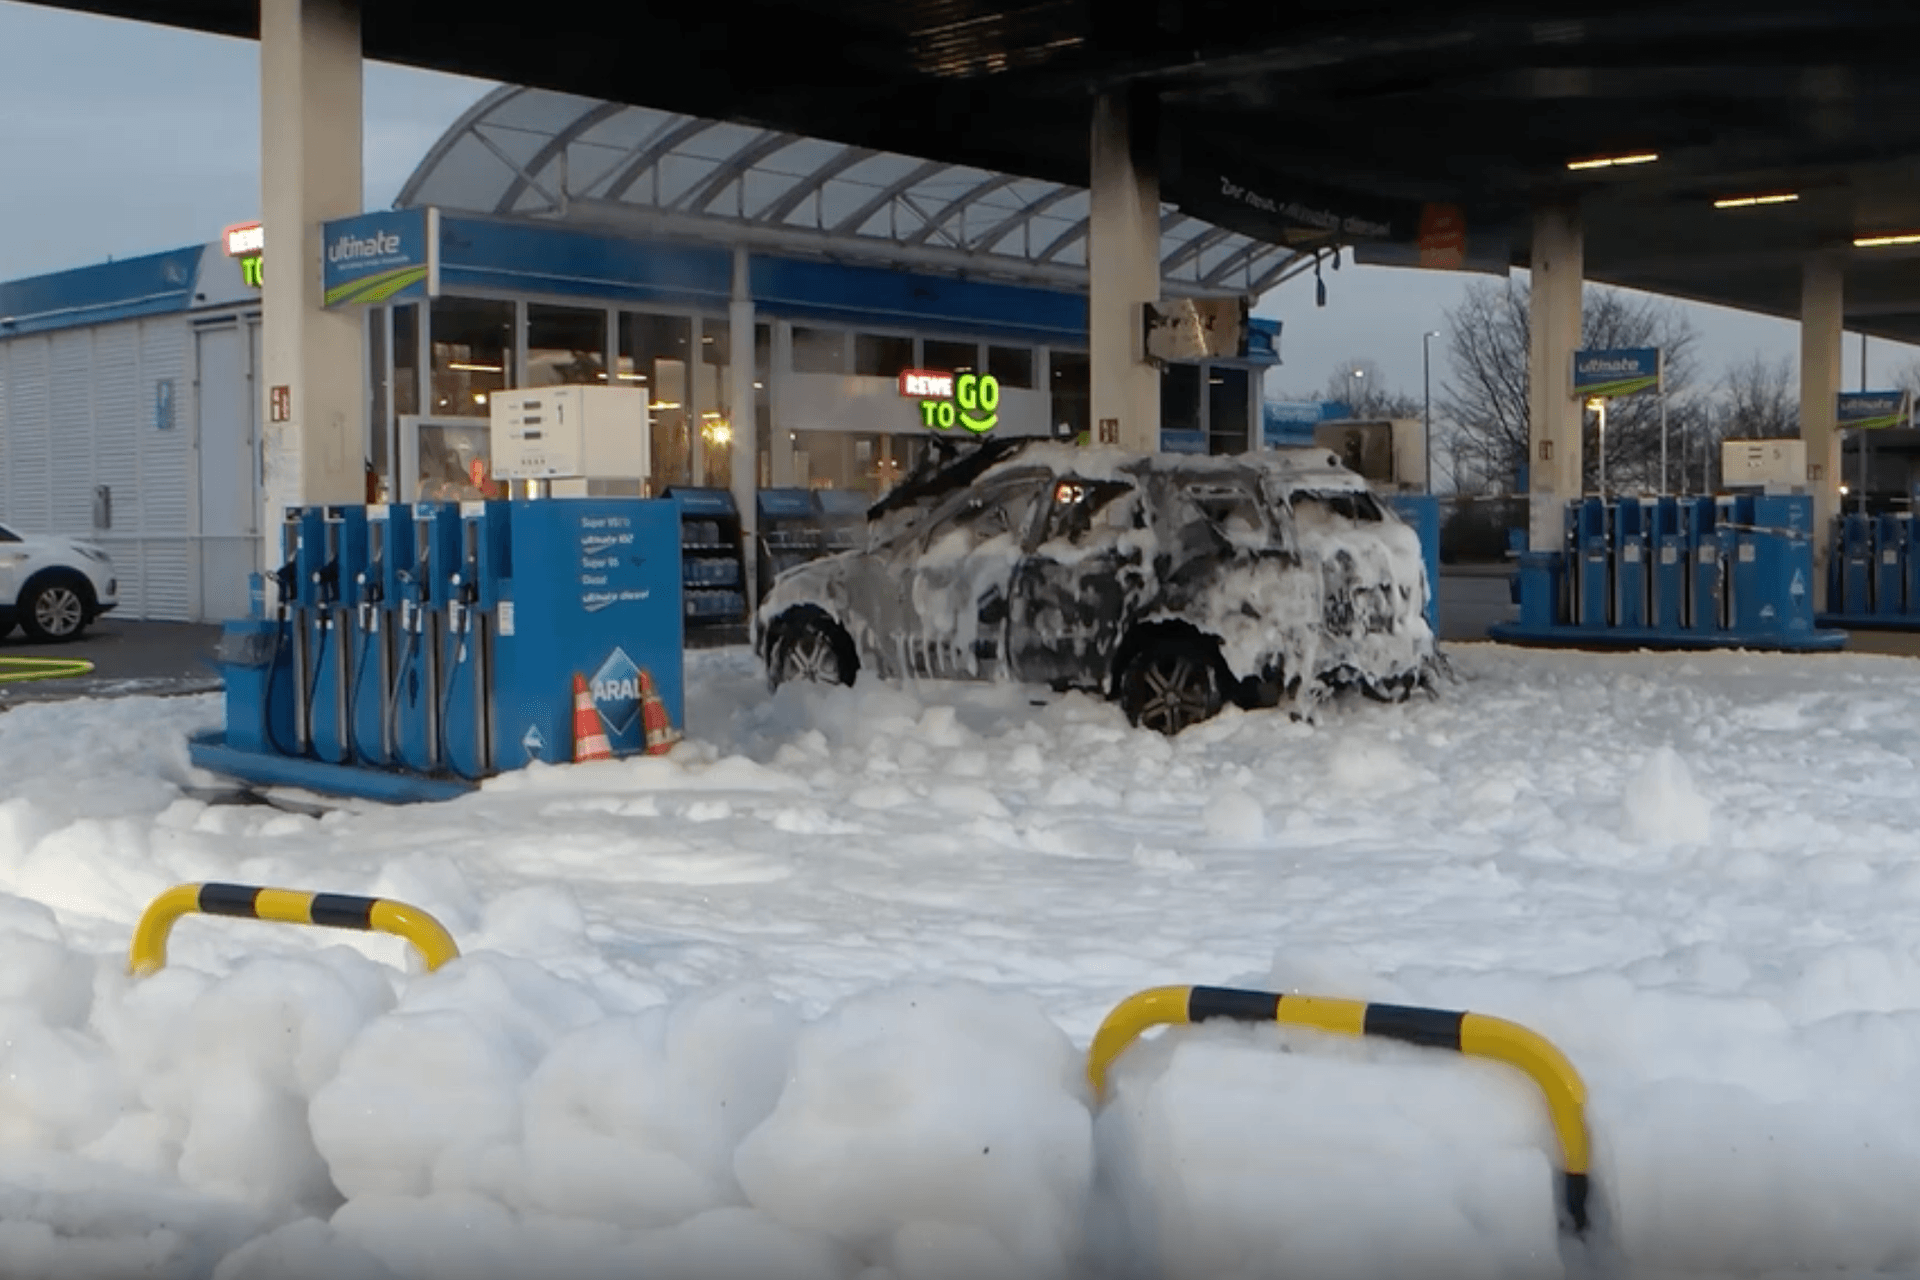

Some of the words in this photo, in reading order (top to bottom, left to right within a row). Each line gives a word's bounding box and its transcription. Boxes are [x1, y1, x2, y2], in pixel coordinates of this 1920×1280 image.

[327, 230, 401, 262] ultimate
[1578, 358, 1640, 373] ultimate
[906, 374, 953, 397] REWE
[921, 400, 955, 428] TO
[956, 373, 999, 412] GO
[594, 678, 642, 702] ARAL
